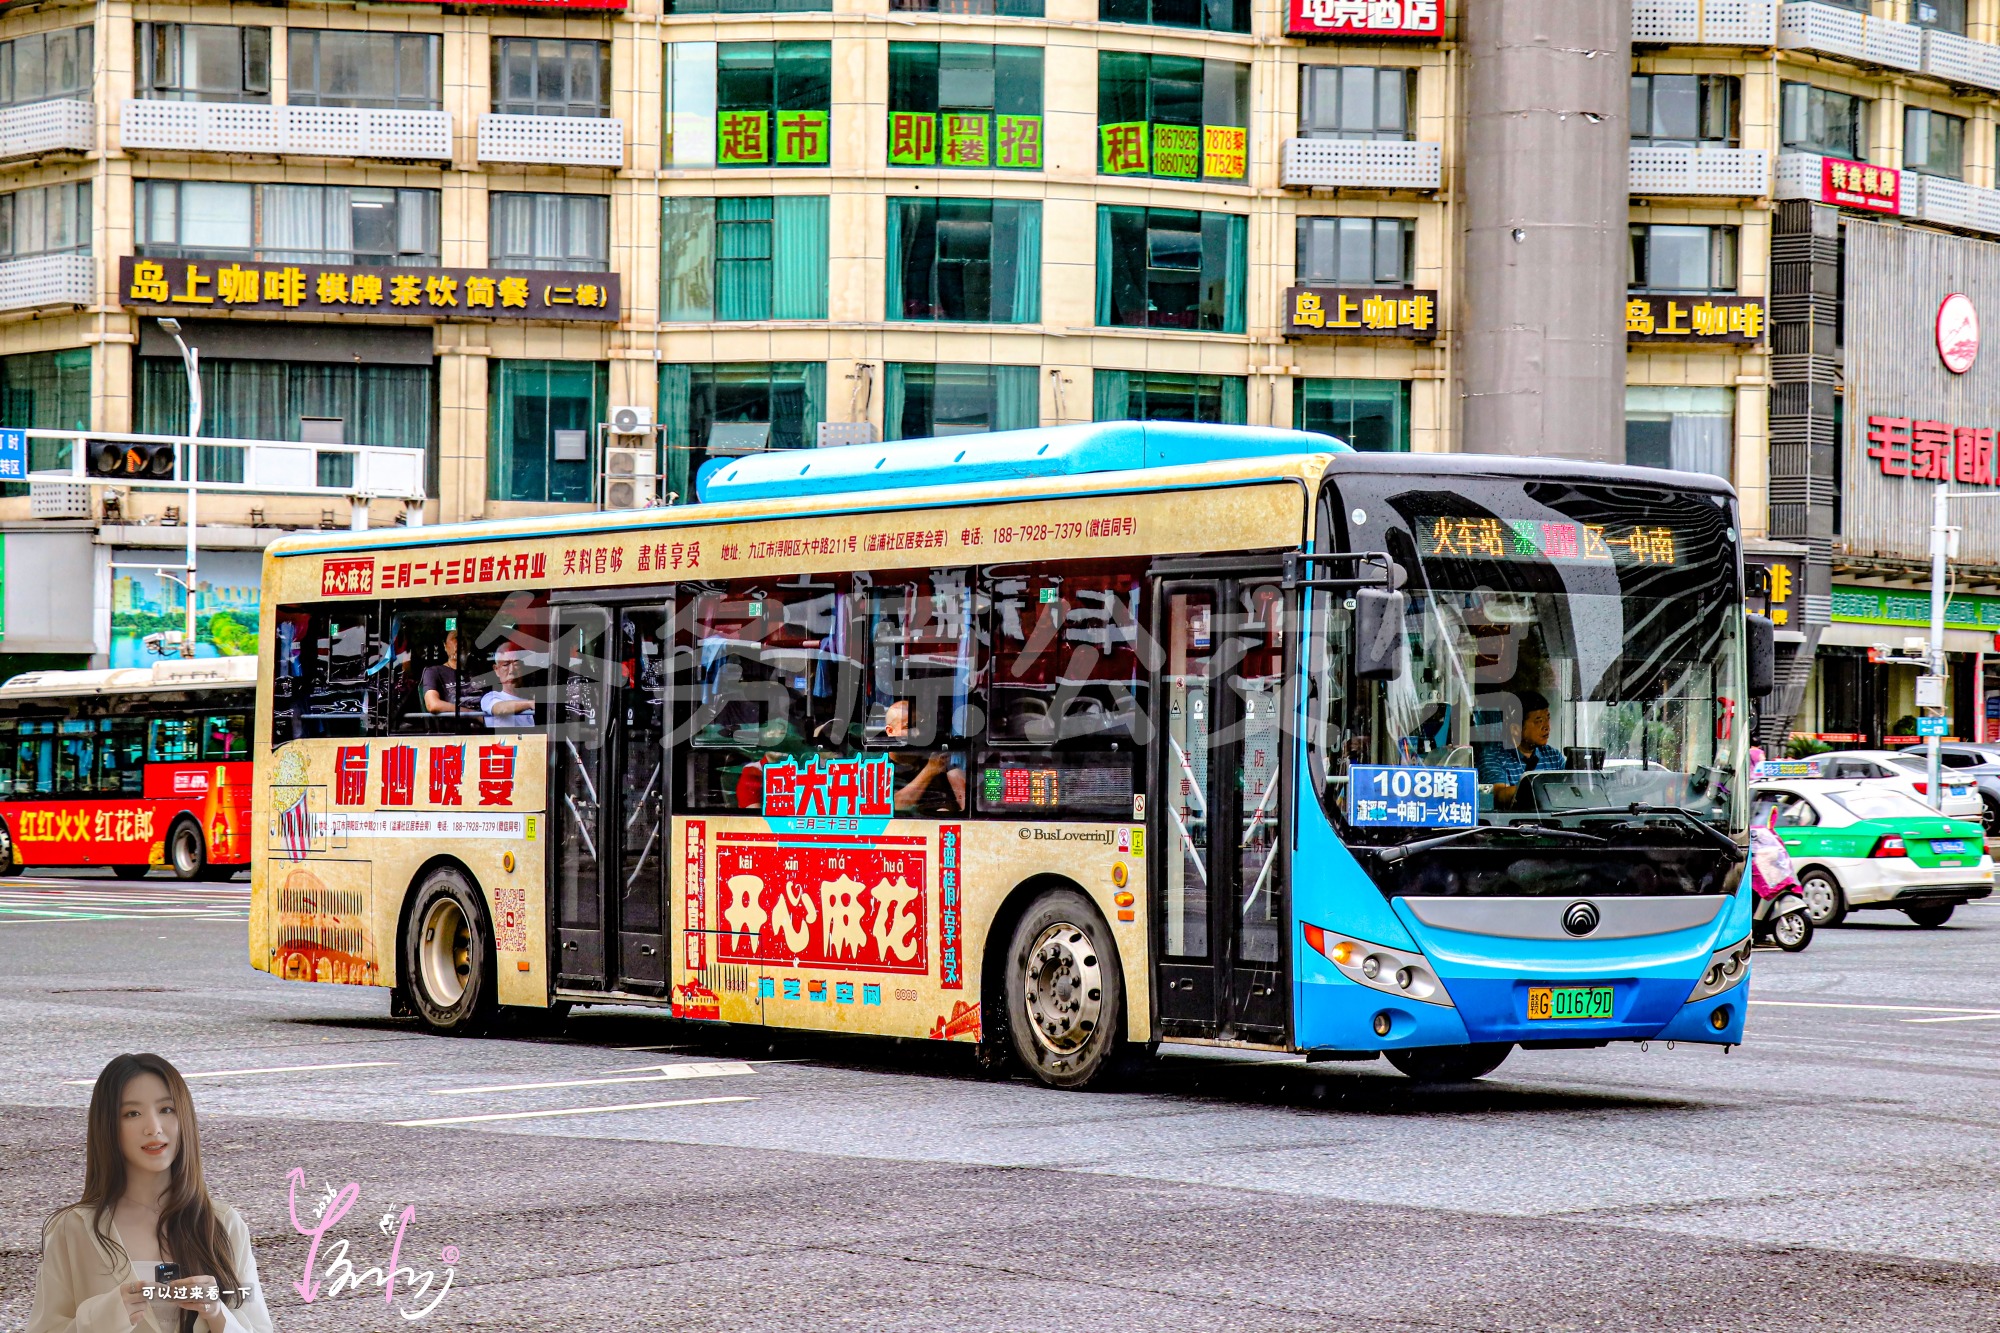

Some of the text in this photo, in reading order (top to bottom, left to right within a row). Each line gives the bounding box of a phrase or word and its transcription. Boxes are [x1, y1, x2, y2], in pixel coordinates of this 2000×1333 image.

[723, 113, 822, 160] 超市
[1106, 126, 1145, 172] 租
[130, 260, 307, 307] 岛上咖啡
[316, 272, 383, 305] 棋牌
[390, 274, 458, 307] 茶饮
[465, 275, 529, 309] 简餐
[1293, 291, 1434, 331] 岛上咖啡
[1625, 298, 1764, 338] 岛上咖啡
[1433, 516, 1505, 556] 火车站
[563, 546, 625, 576] 笑料管够
[765, 752, 894, 818] 盛大开业
[1179, 750, 1193, 852] 注意开门
[1252, 749, 1267, 853] 防止夹伤
[1373, 769, 1459, 800] 108路
[19, 807, 154, 842] 红红火火 红花郎
[724, 872, 920, 963] 开心麻花
